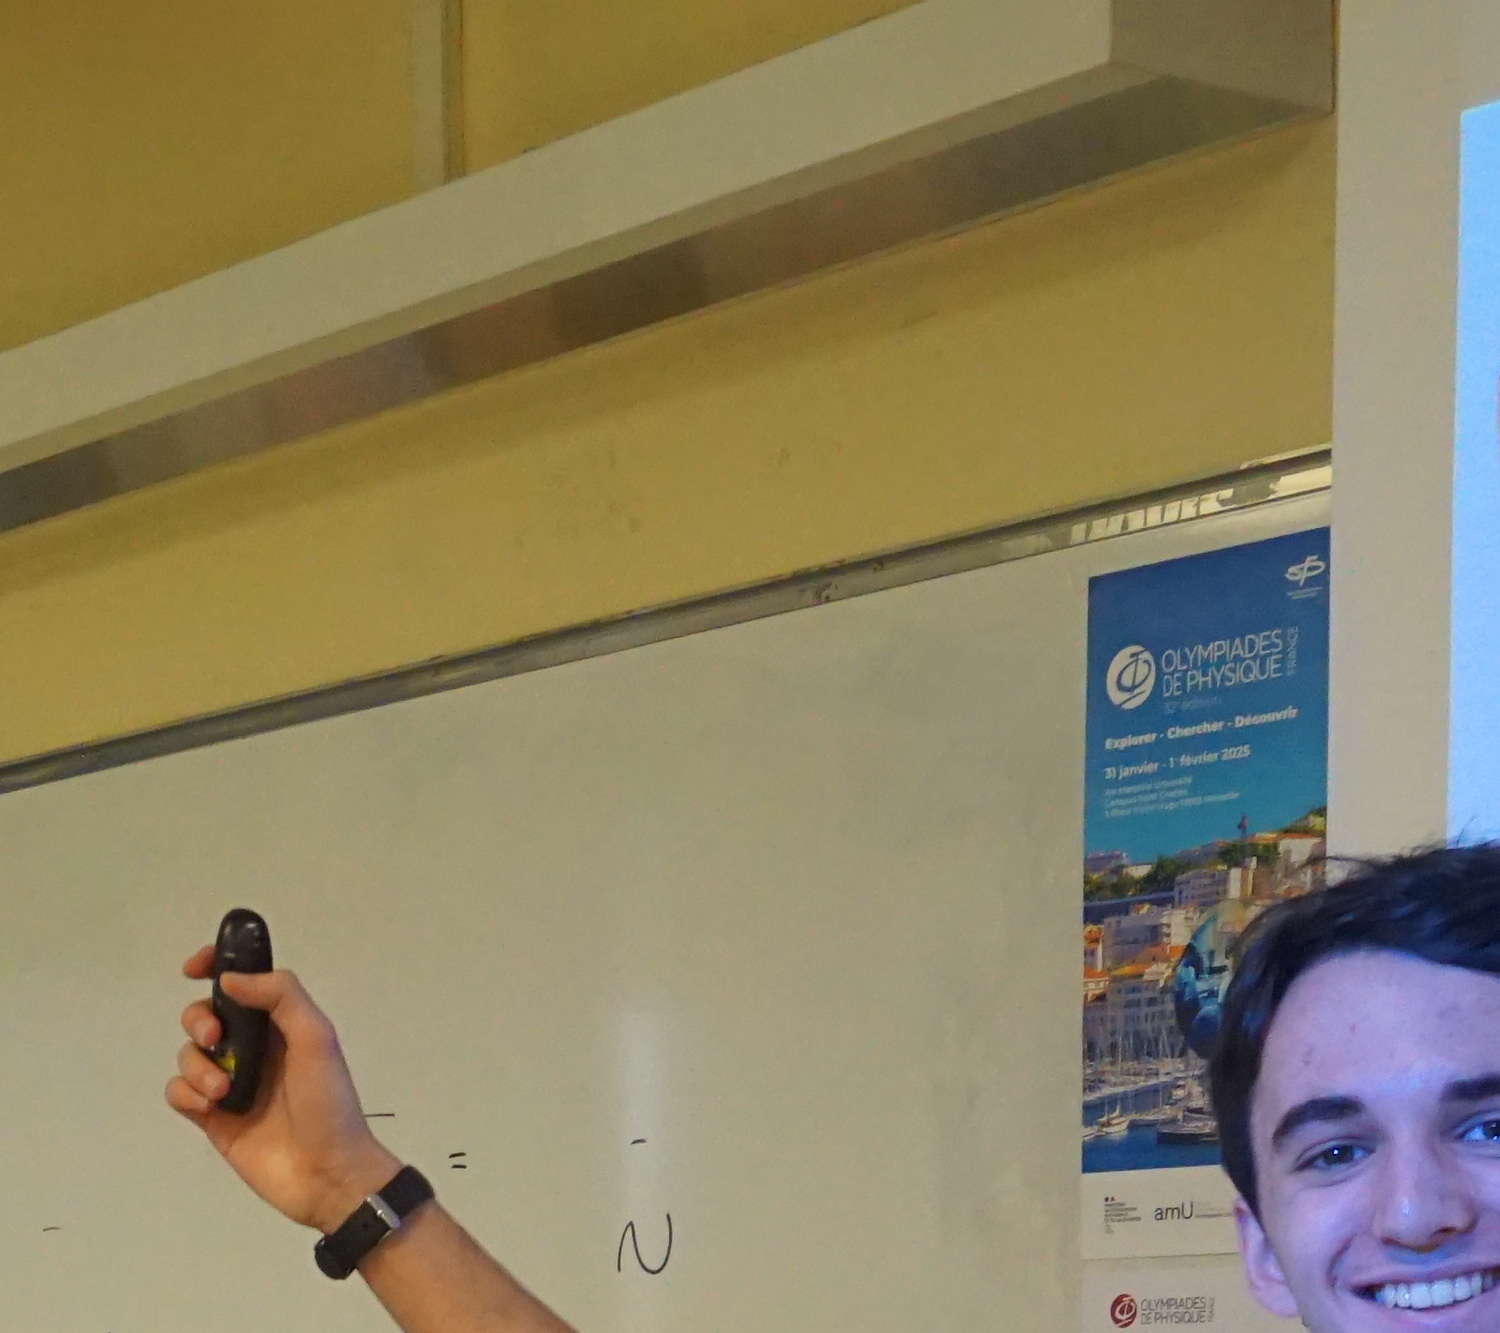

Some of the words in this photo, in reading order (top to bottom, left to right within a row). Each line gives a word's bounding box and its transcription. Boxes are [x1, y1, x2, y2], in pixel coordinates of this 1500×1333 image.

[1162, 630, 1283, 672] OLYMPIADES
[1163, 672, 1183, 698] DE
[1186, 655, 1283, 693] PHYSIQUE
[1118, 761, 1159, 780] janvier
[1140, 1296, 1206, 1311] OLYMPIADES
[1154, 1310, 1206, 1324] PHYSIQUE
